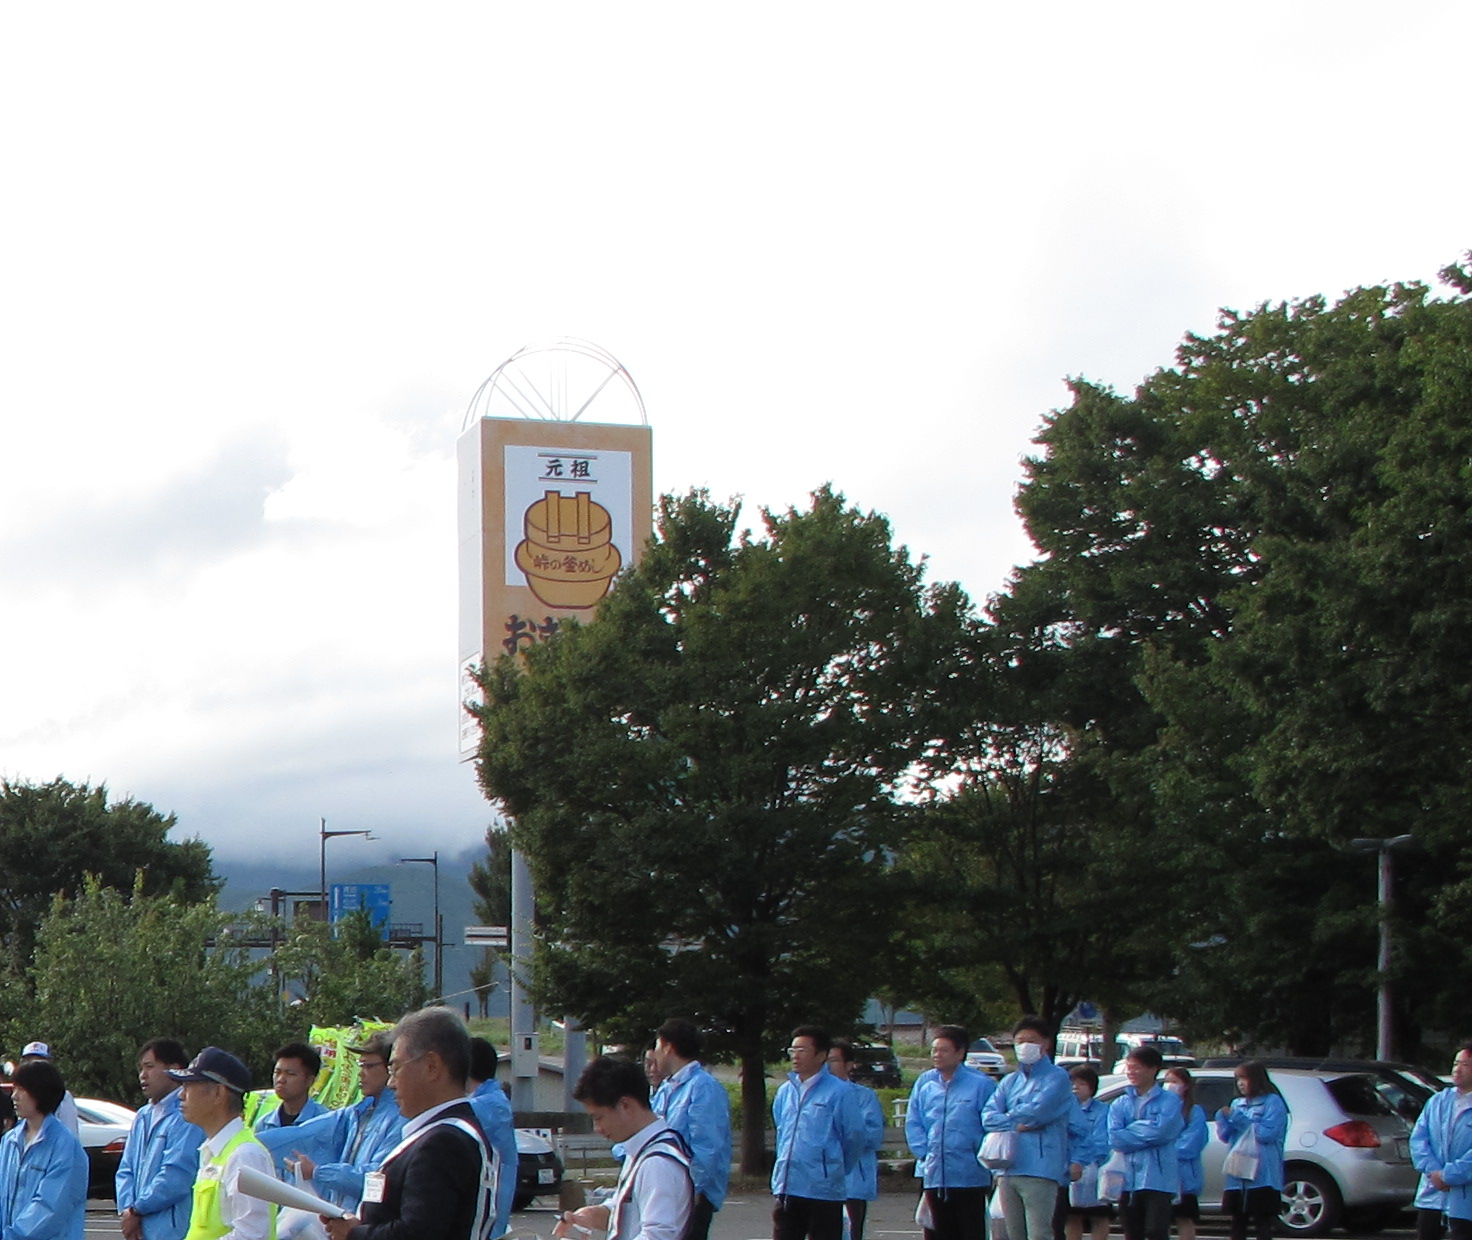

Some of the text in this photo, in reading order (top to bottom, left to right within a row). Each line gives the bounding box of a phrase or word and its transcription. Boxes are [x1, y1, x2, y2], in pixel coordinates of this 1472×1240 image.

[544, 458, 591, 478] 元祖
[533, 553, 603, 574] 峠の釜めし
